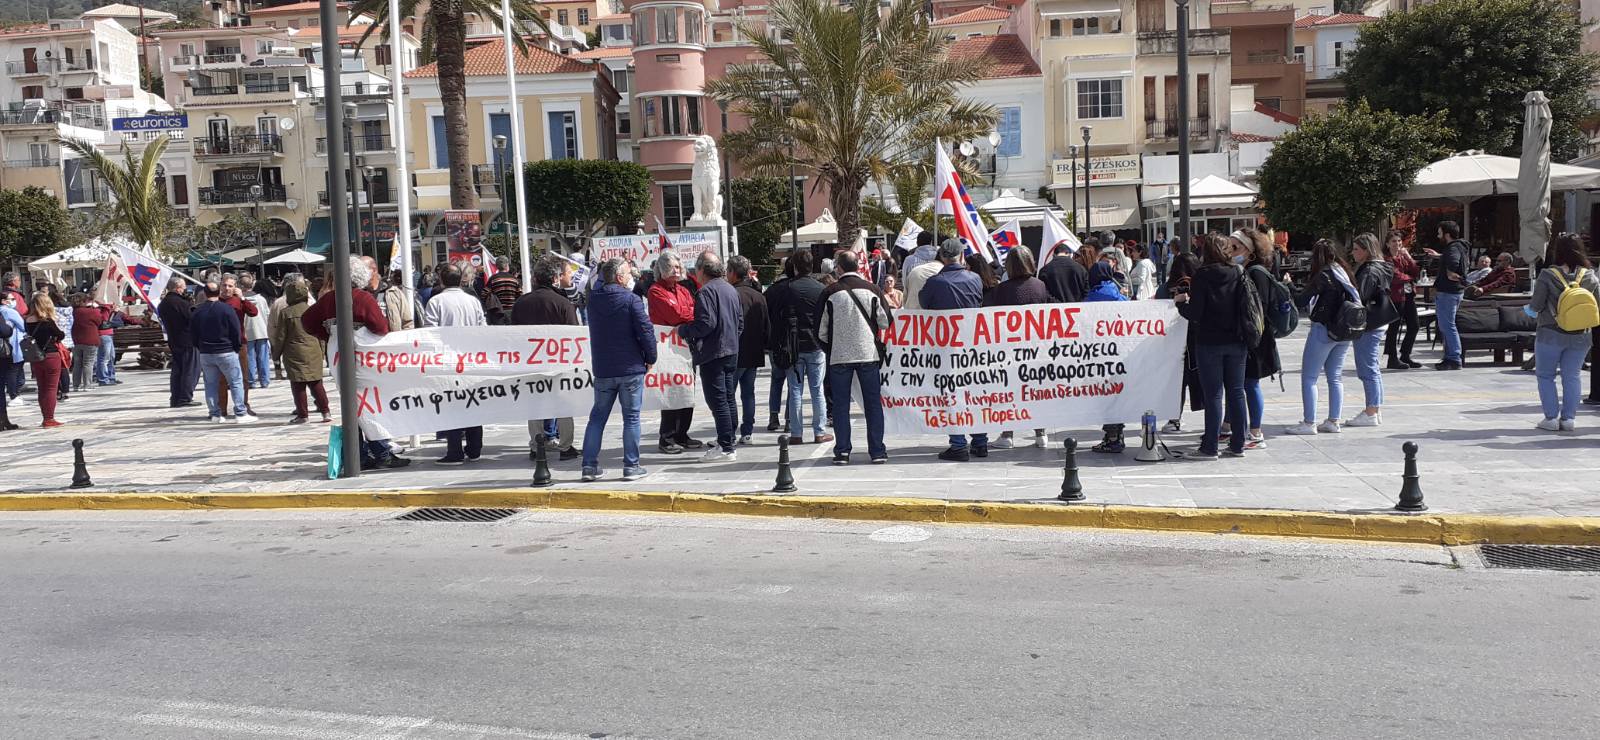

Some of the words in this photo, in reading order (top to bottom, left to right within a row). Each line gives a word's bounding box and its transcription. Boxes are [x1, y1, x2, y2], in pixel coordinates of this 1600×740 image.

[131, 117, 182, 129] euronics
[232, 172, 256, 181] Nikos
[879, 314, 964, 347] ΑΖΙΚΟΣ
[973, 308, 1080, 345] ΑΓΩΝΑΣ
[456, 351, 488, 373] για
[497, 351, 520, 364] τις
[527, 337, 588, 364] ΖΩΕΣ
[900, 348, 941, 369] άδικο
[1013, 347, 1039, 361] την
[1048, 341, 1119, 360] φτώχεια
[901, 372, 925, 387] την
[934, 366, 1008, 395] εργασιακή
[1018, 360, 1127, 384] βαρβαρότητα
[356, 386, 382, 417] ΧΙ
[389, 395, 424, 411] στη
[429, 380, 507, 415] φτώχεια
[526, 378, 553, 394] τον
[560, 368, 594, 390] πόλ
[645, 373, 693, 393] αμου
[964, 390, 1014, 406] Κινήσεις
[922, 407, 974, 427] Ταξική
[981, 403, 1031, 425] Πορεία
